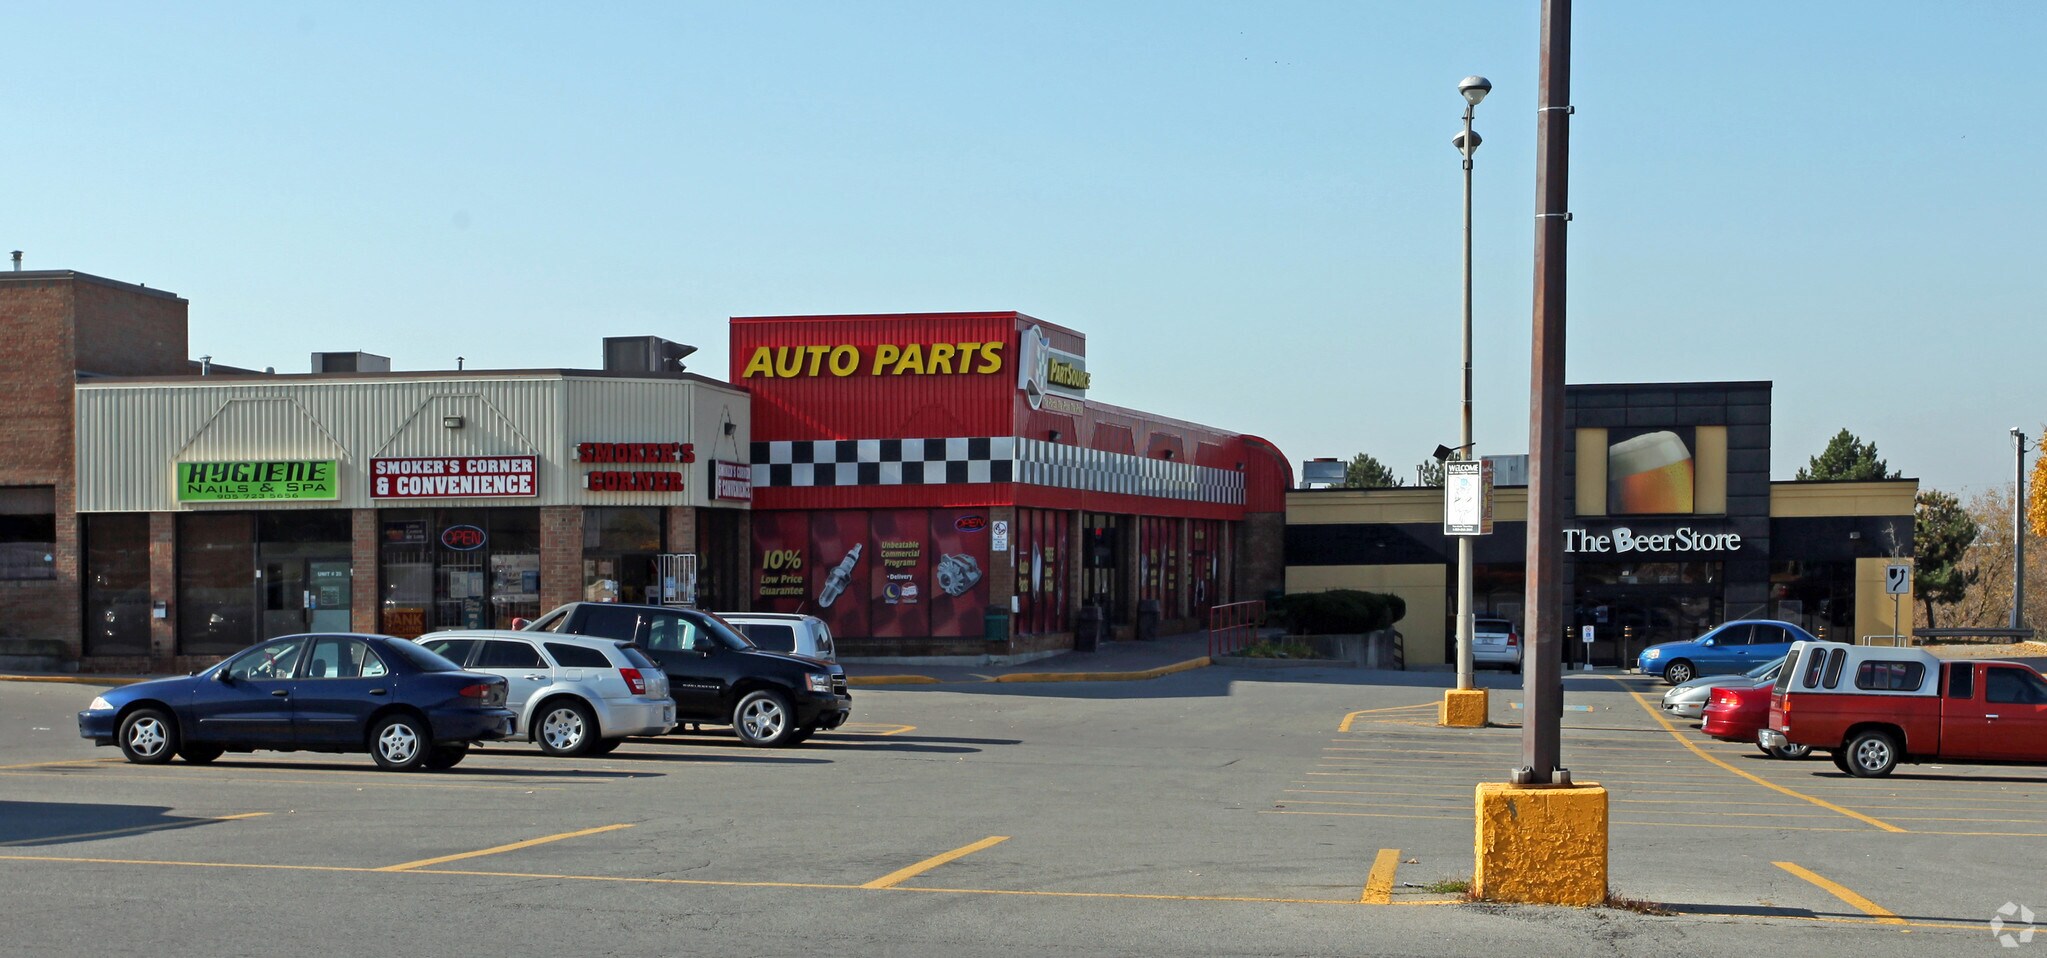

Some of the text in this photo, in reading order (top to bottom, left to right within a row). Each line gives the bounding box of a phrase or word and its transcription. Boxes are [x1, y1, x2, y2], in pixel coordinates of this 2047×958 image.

[742, 341, 1004, 379] AUTO PARTS
[579, 441, 696, 464] SMOKER'S
[187, 461, 328, 484] HYGIENE
[375, 458, 533, 475] SMOKER'S CORNER
[1448, 463, 1479, 472] WELCOME
[259, 482, 274, 493] &
[376, 474, 531, 495] & CONVENIENCE
[588, 470, 685, 492] CORNER
[958, 518, 986, 529] OPEN
[443, 530, 482, 546] OPEN
[1562, 526, 1741, 554] The Beer Store
[881, 541, 920, 550] Unbeatable
[762, 549, 802, 570] 10%
[880, 550, 921, 558] Commercial
[884, 559, 917, 569] Programs
[760, 574, 803, 584] Low Price
[889, 573, 913, 581] Delivery
[759, 586, 805, 596] Guarantee
